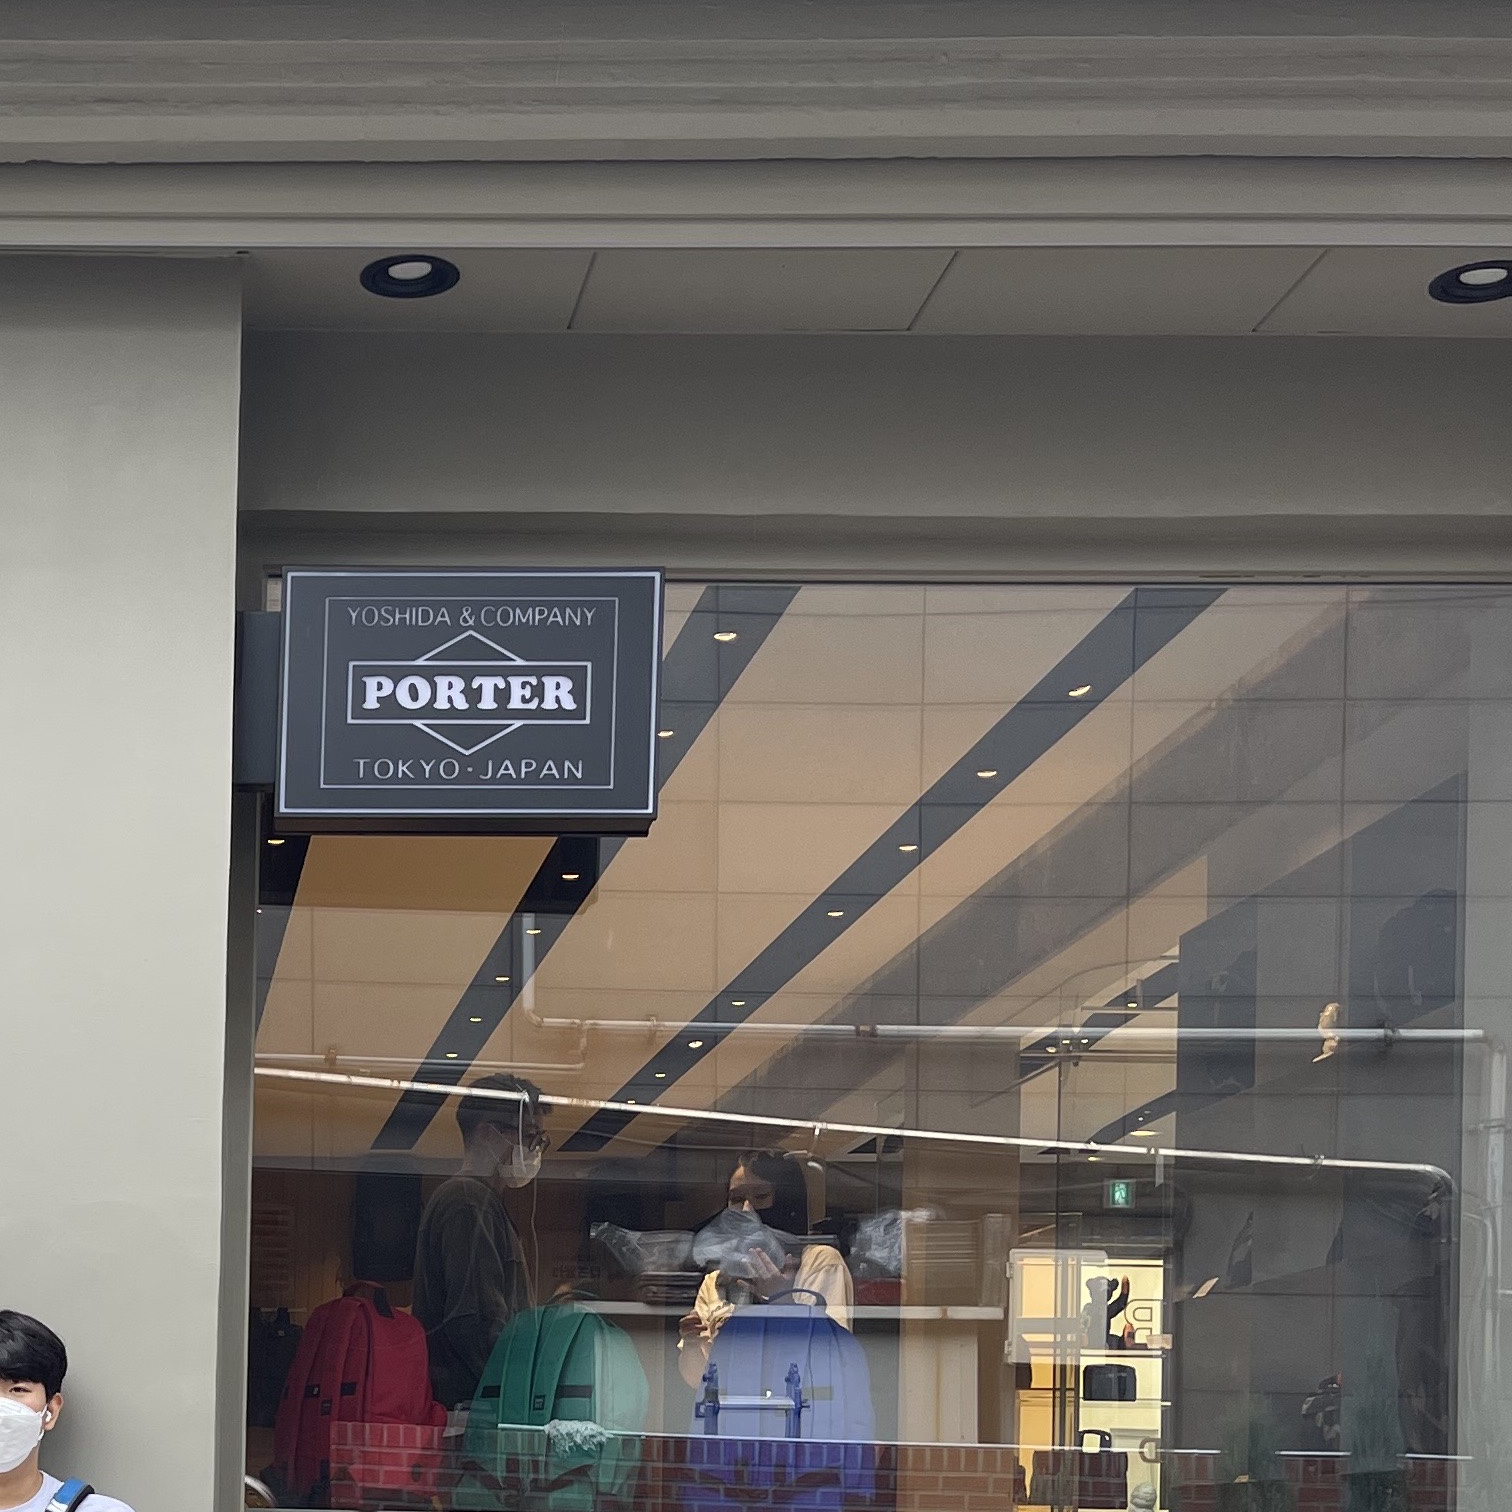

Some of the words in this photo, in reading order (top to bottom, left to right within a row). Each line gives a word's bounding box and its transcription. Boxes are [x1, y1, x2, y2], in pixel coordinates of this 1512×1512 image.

[347, 606, 450, 627] YOSHIDA
[459, 606, 476, 627] &
[481, 606, 597, 627] COMPANY
[361, 675, 578, 710] PORTER
